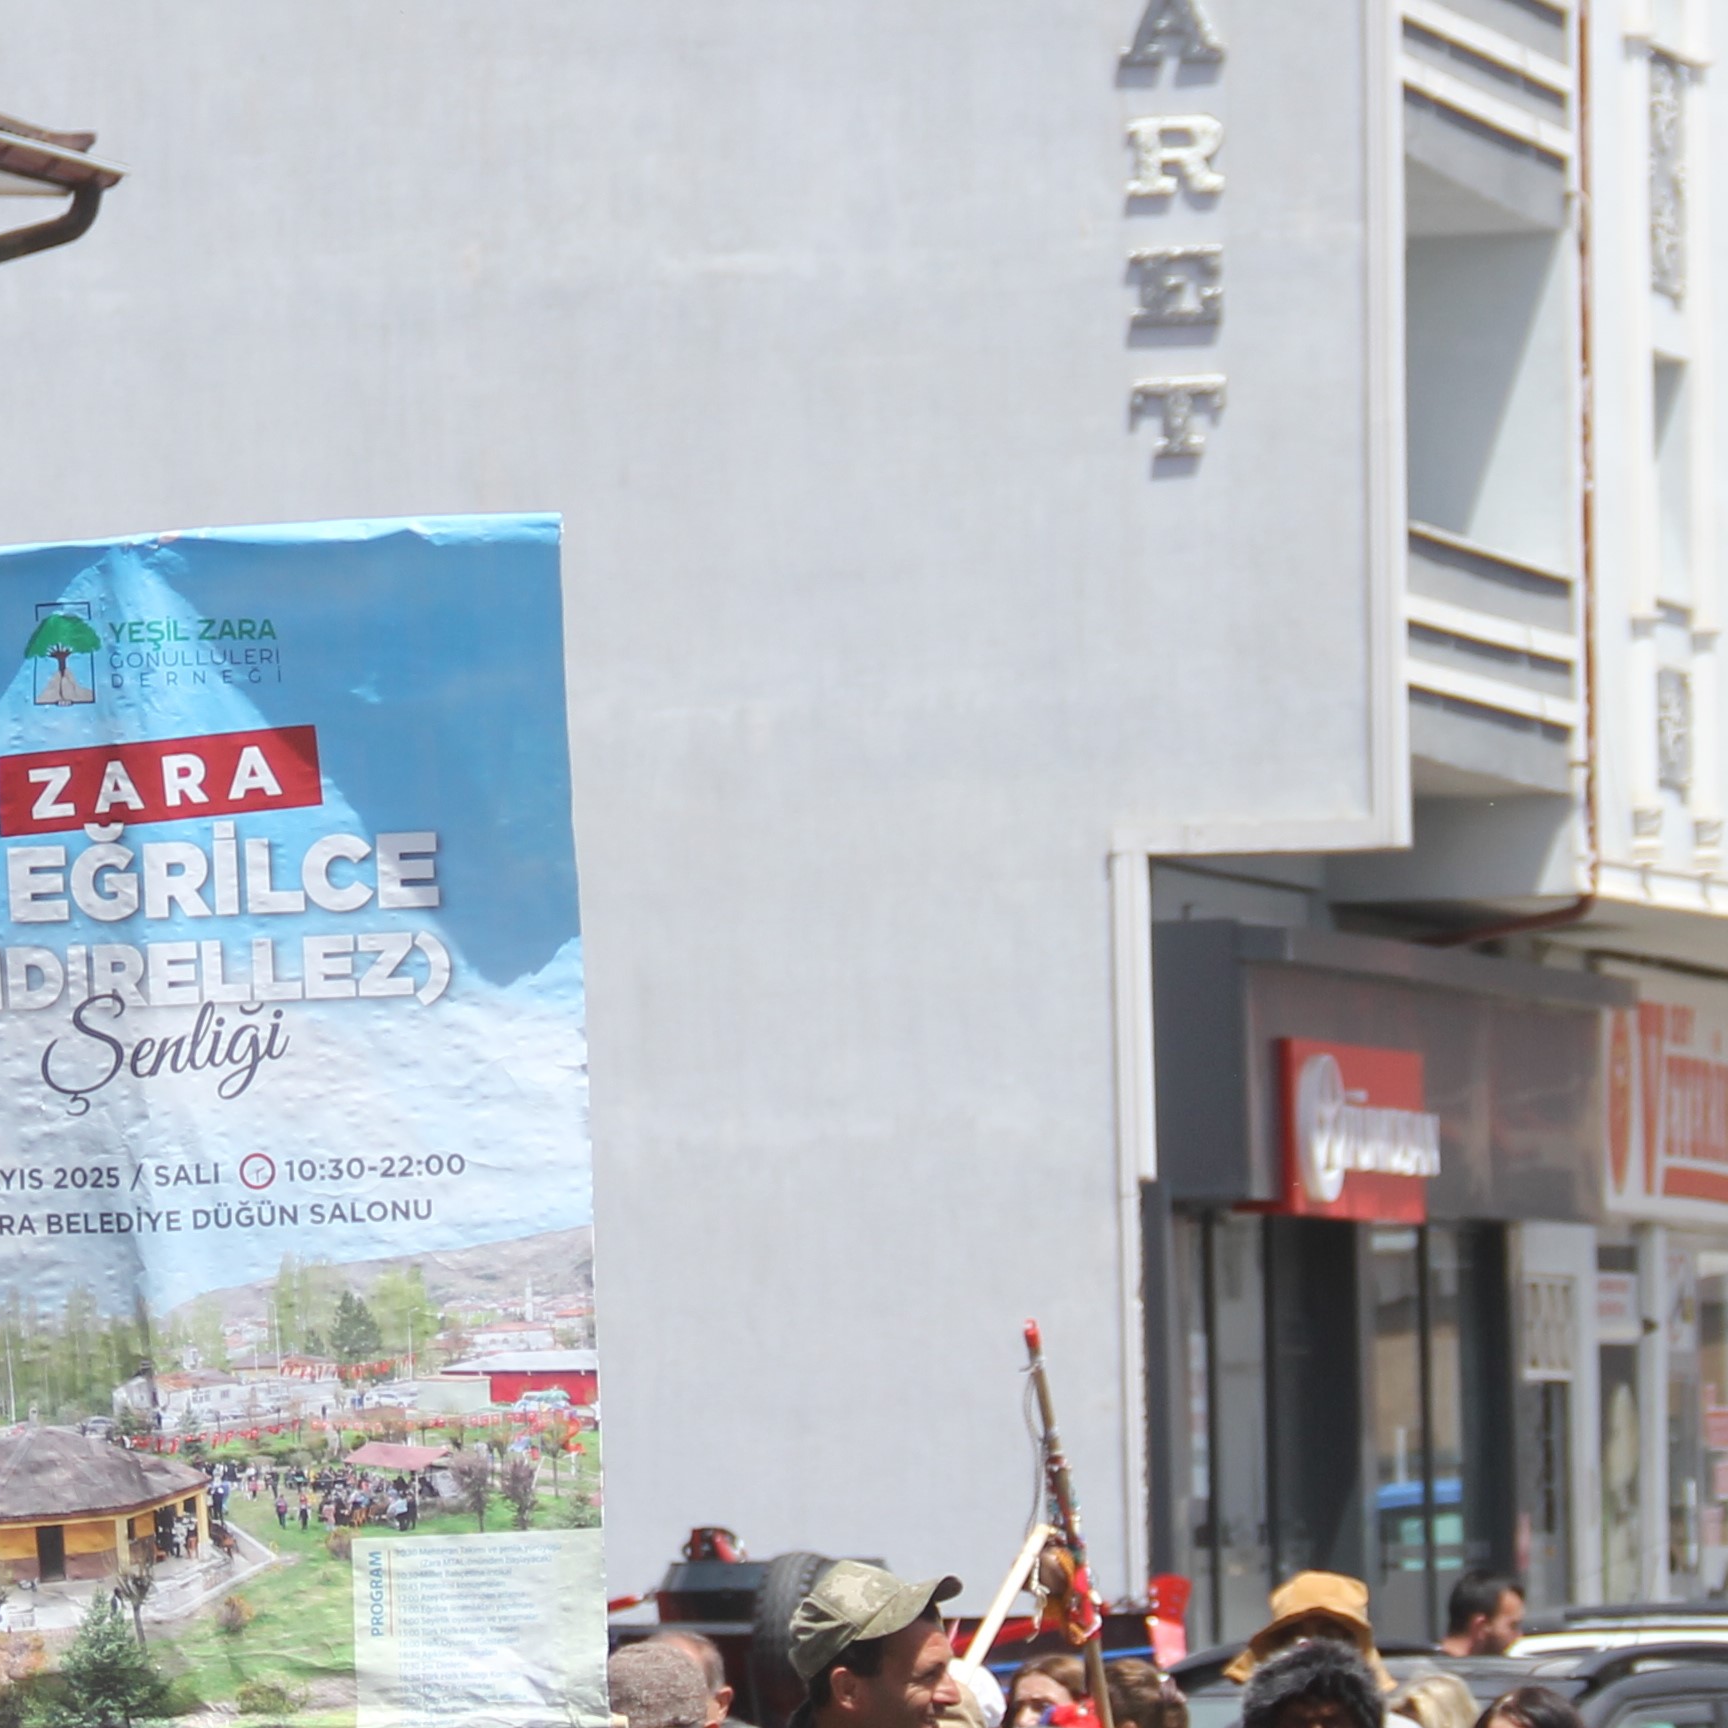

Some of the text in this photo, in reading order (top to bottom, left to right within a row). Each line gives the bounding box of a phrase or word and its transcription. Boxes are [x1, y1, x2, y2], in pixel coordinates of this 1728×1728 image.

[109, 616, 277, 651] YEŞİL ZARA
[28, 745, 283, 820] ZARA
[7, 821, 440, 923] EĞRİLCE
[41, 994, 290, 1117] Şenliği
[53, 1166, 121, 1189] 2025
[130, 1163, 144, 1191] /
[154, 1163, 220, 1187] SALI
[284, 1153, 466, 1182] 10:30-22:00
[46, 1206, 183, 1236] BELEDİYE
[192, 1200, 299, 1230] DÜĞÜN
[310, 1199, 433, 1225] SALONU
[369, 1551, 385, 1637] PROGRAM
